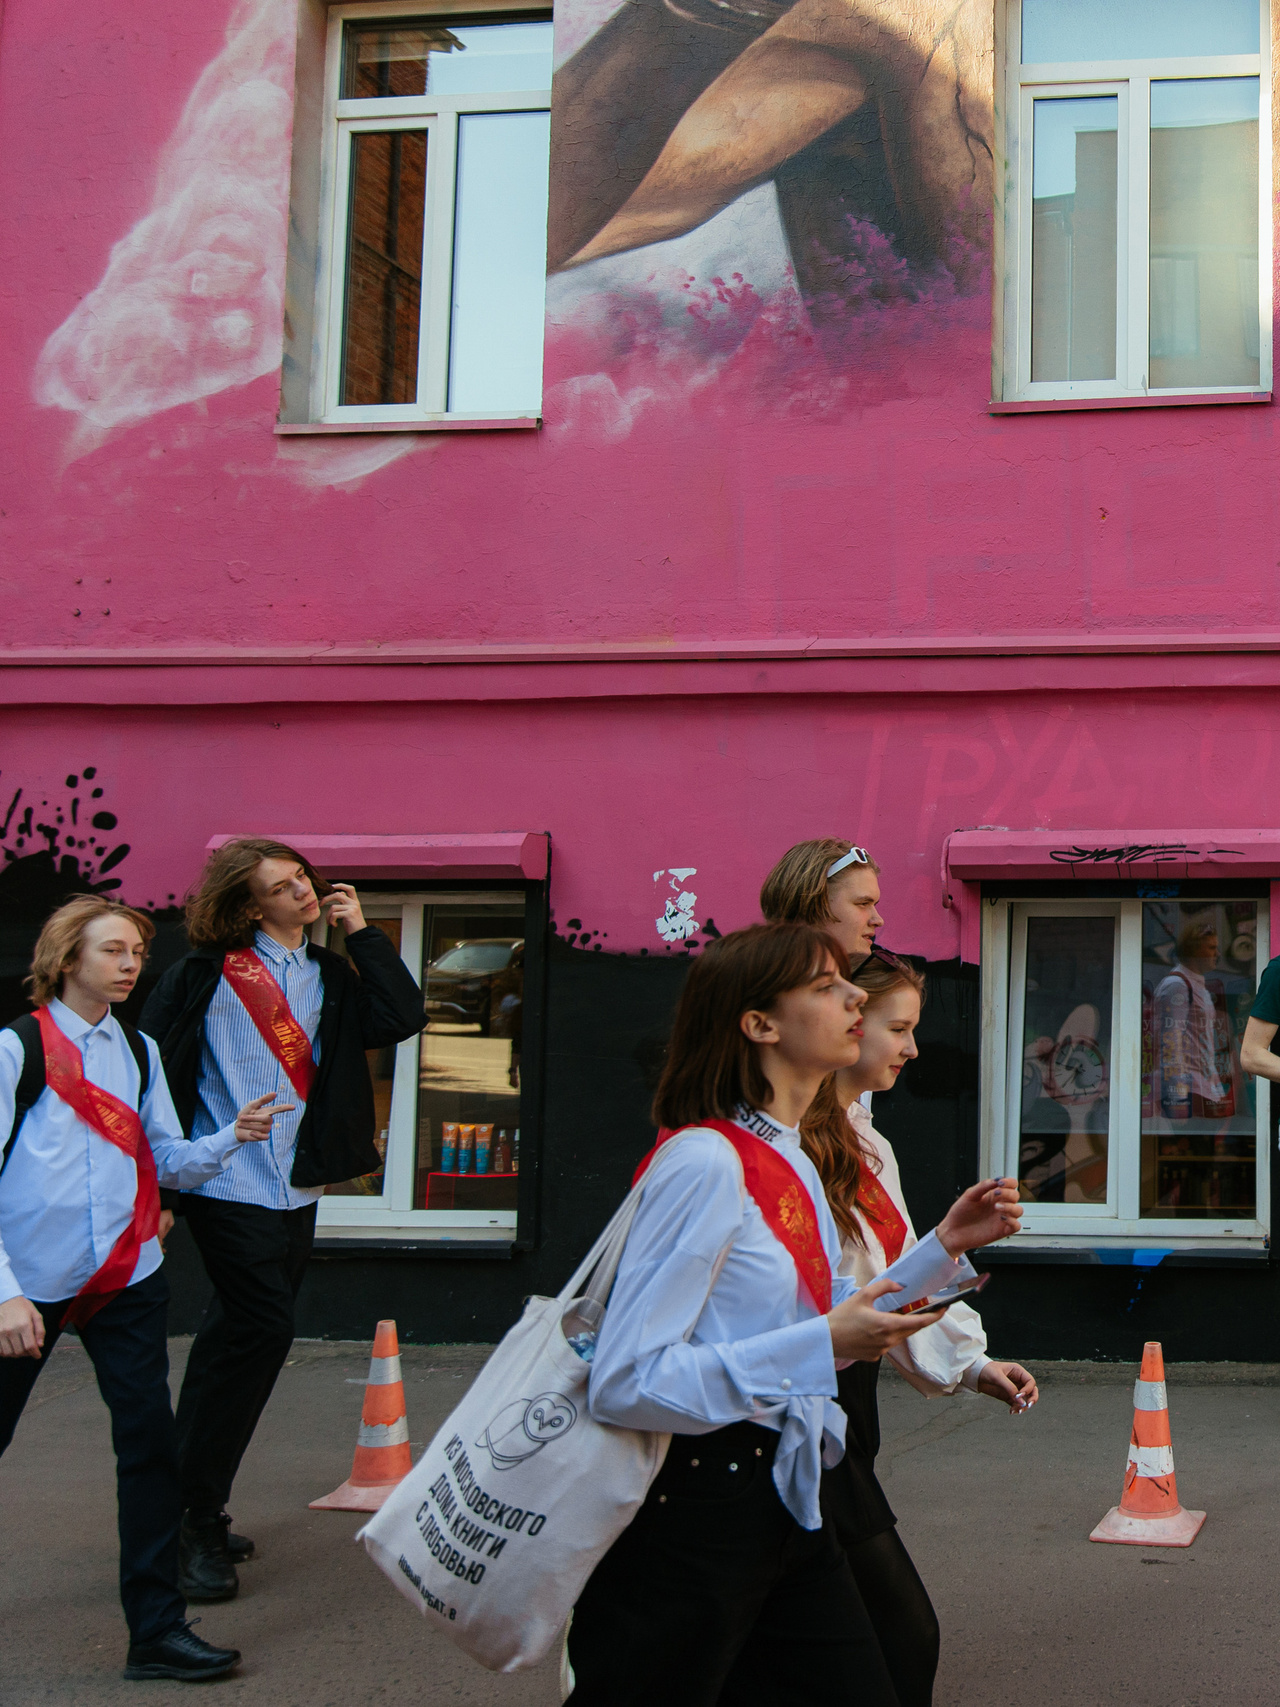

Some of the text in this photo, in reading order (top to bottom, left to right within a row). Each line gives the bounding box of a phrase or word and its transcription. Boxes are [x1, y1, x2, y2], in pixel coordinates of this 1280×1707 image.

[428, 1472, 508, 1560] ДОМА КНИГИ
[444, 1433, 547, 1537] ИЗ МОСКОВСКОГО
[398, 1553, 422, 1592] НОВЫЙ
[415, 1500, 487, 1585] С ЛЮБОВЬЮ
